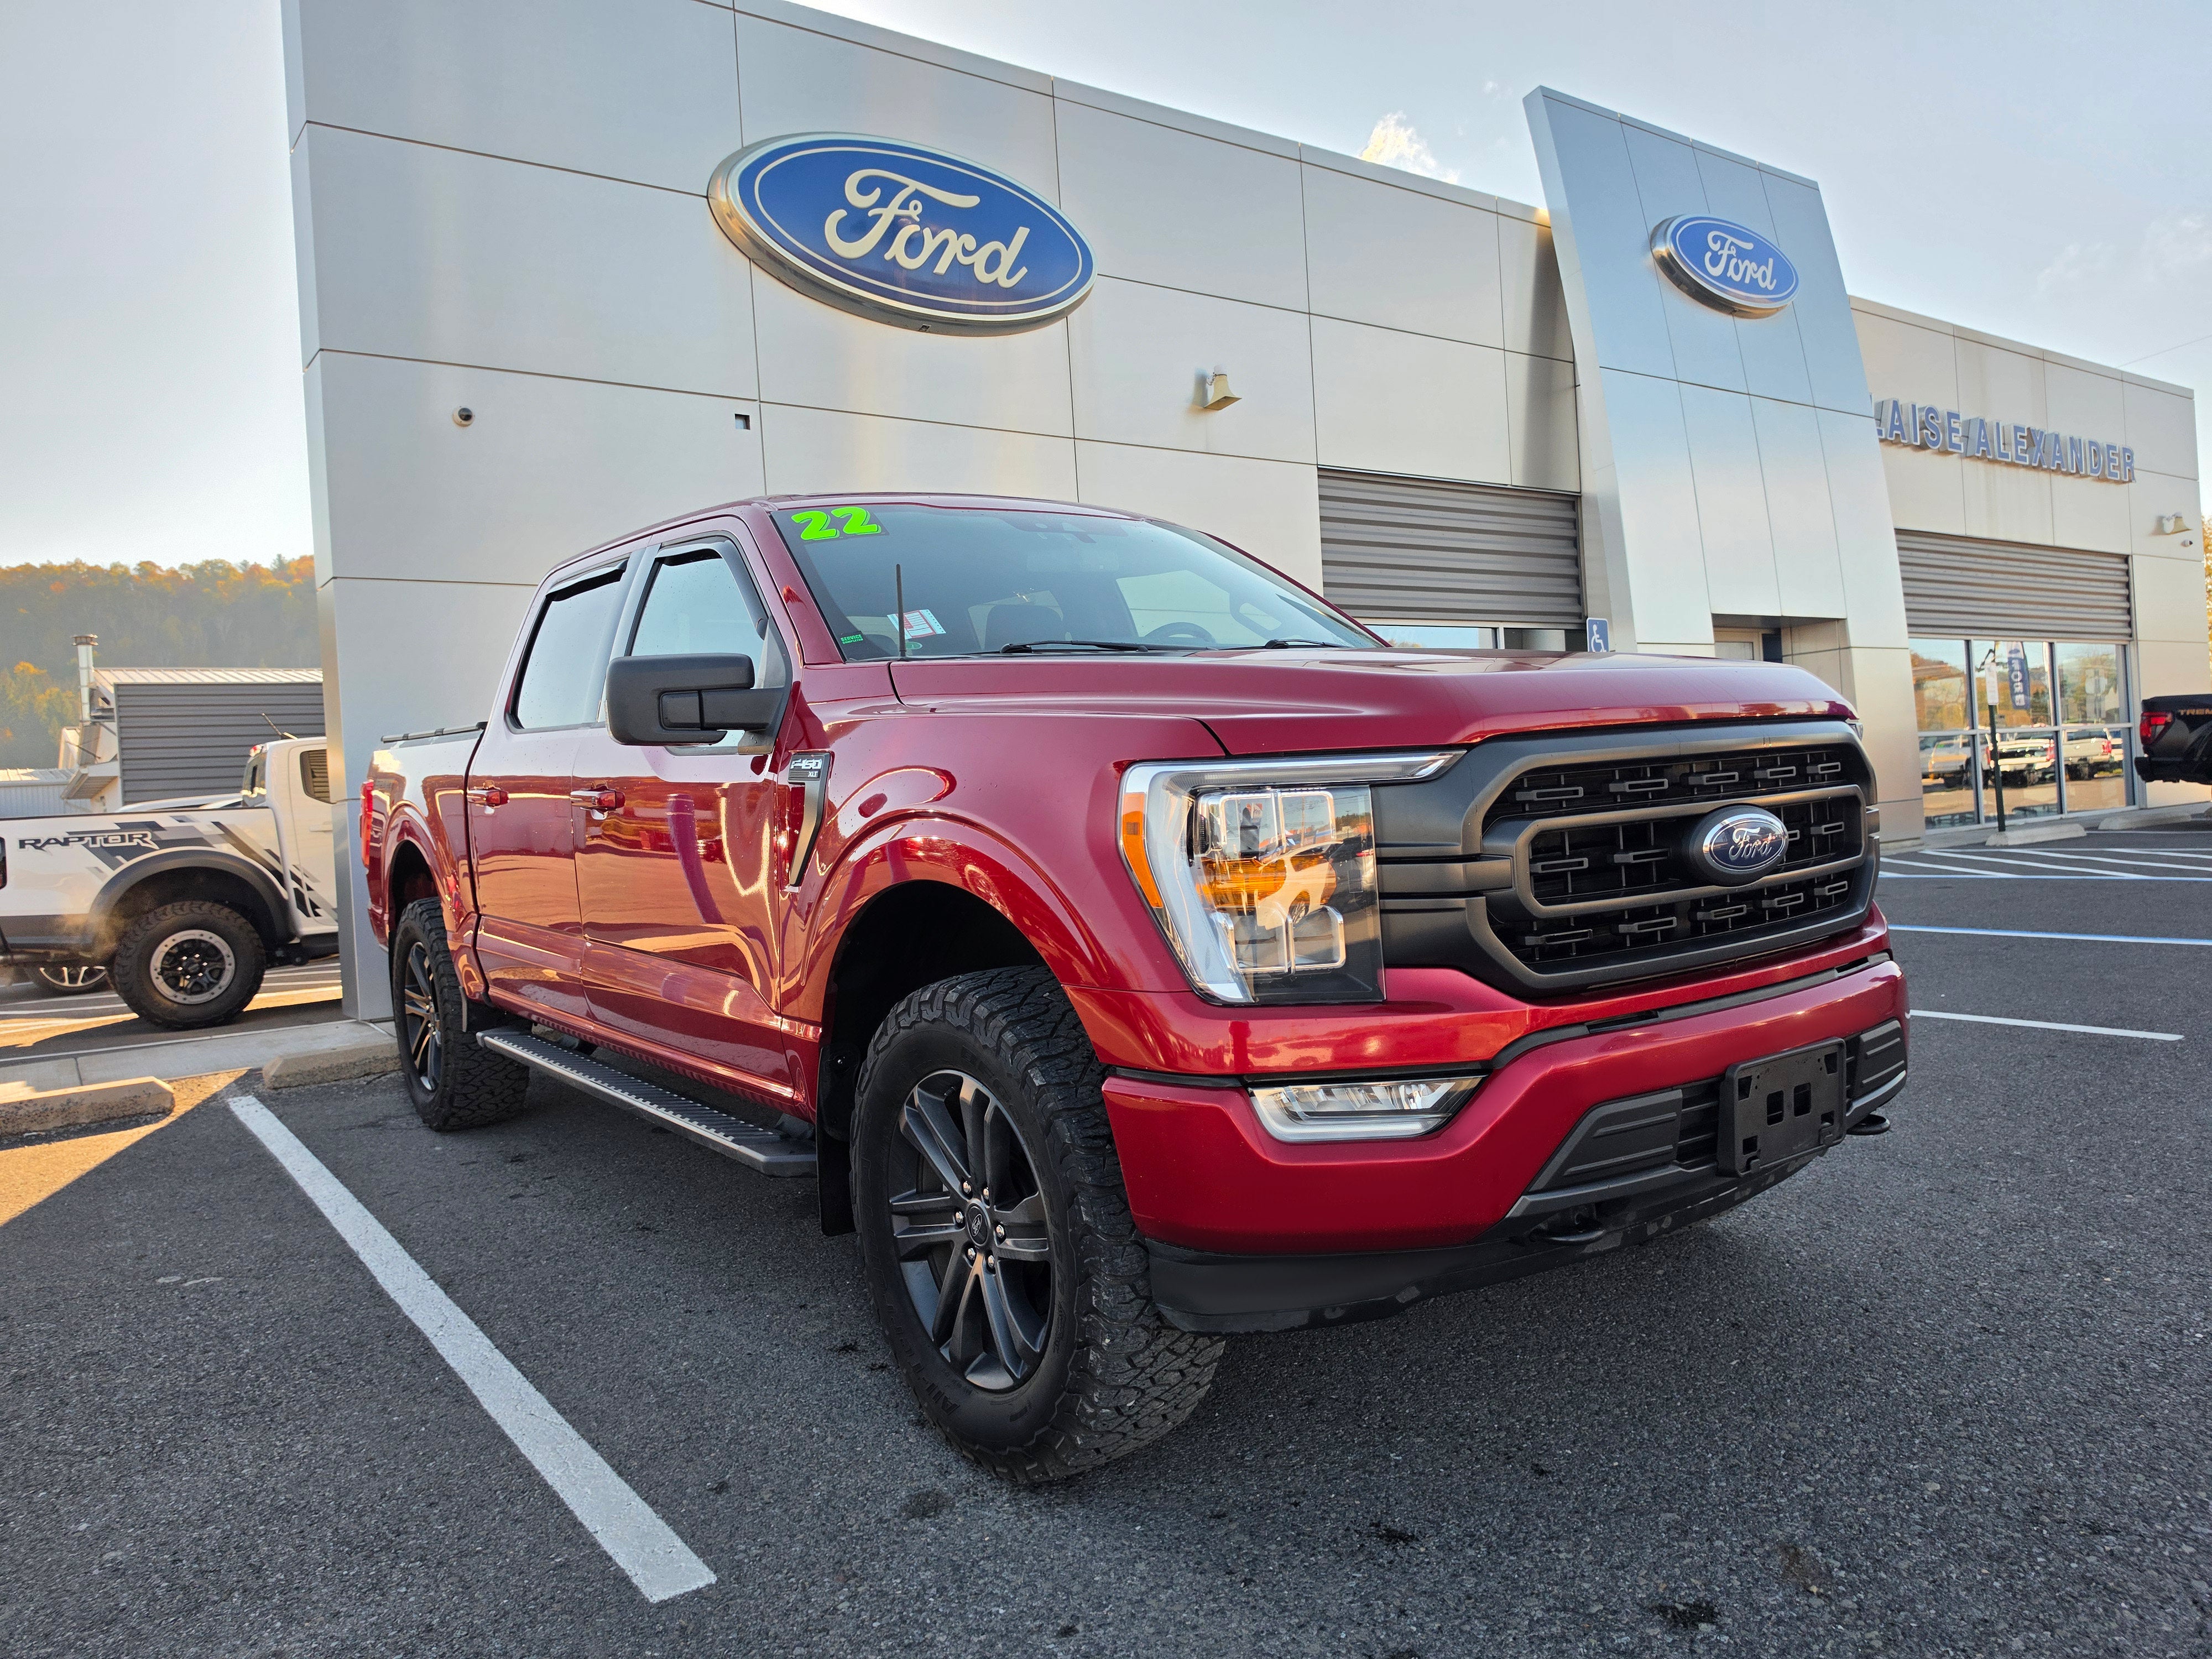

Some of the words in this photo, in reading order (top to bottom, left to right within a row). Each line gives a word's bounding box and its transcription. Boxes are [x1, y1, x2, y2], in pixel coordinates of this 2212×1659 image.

[825, 169, 1030, 289] Ford
[1704, 231, 1777, 290] Ford
[1975, 417, 2136, 483] ALEXANDER
[791, 507, 881, 541] 22
[18, 831, 160, 855] RAPTOR
[1728, 827, 1773, 861] Ford
